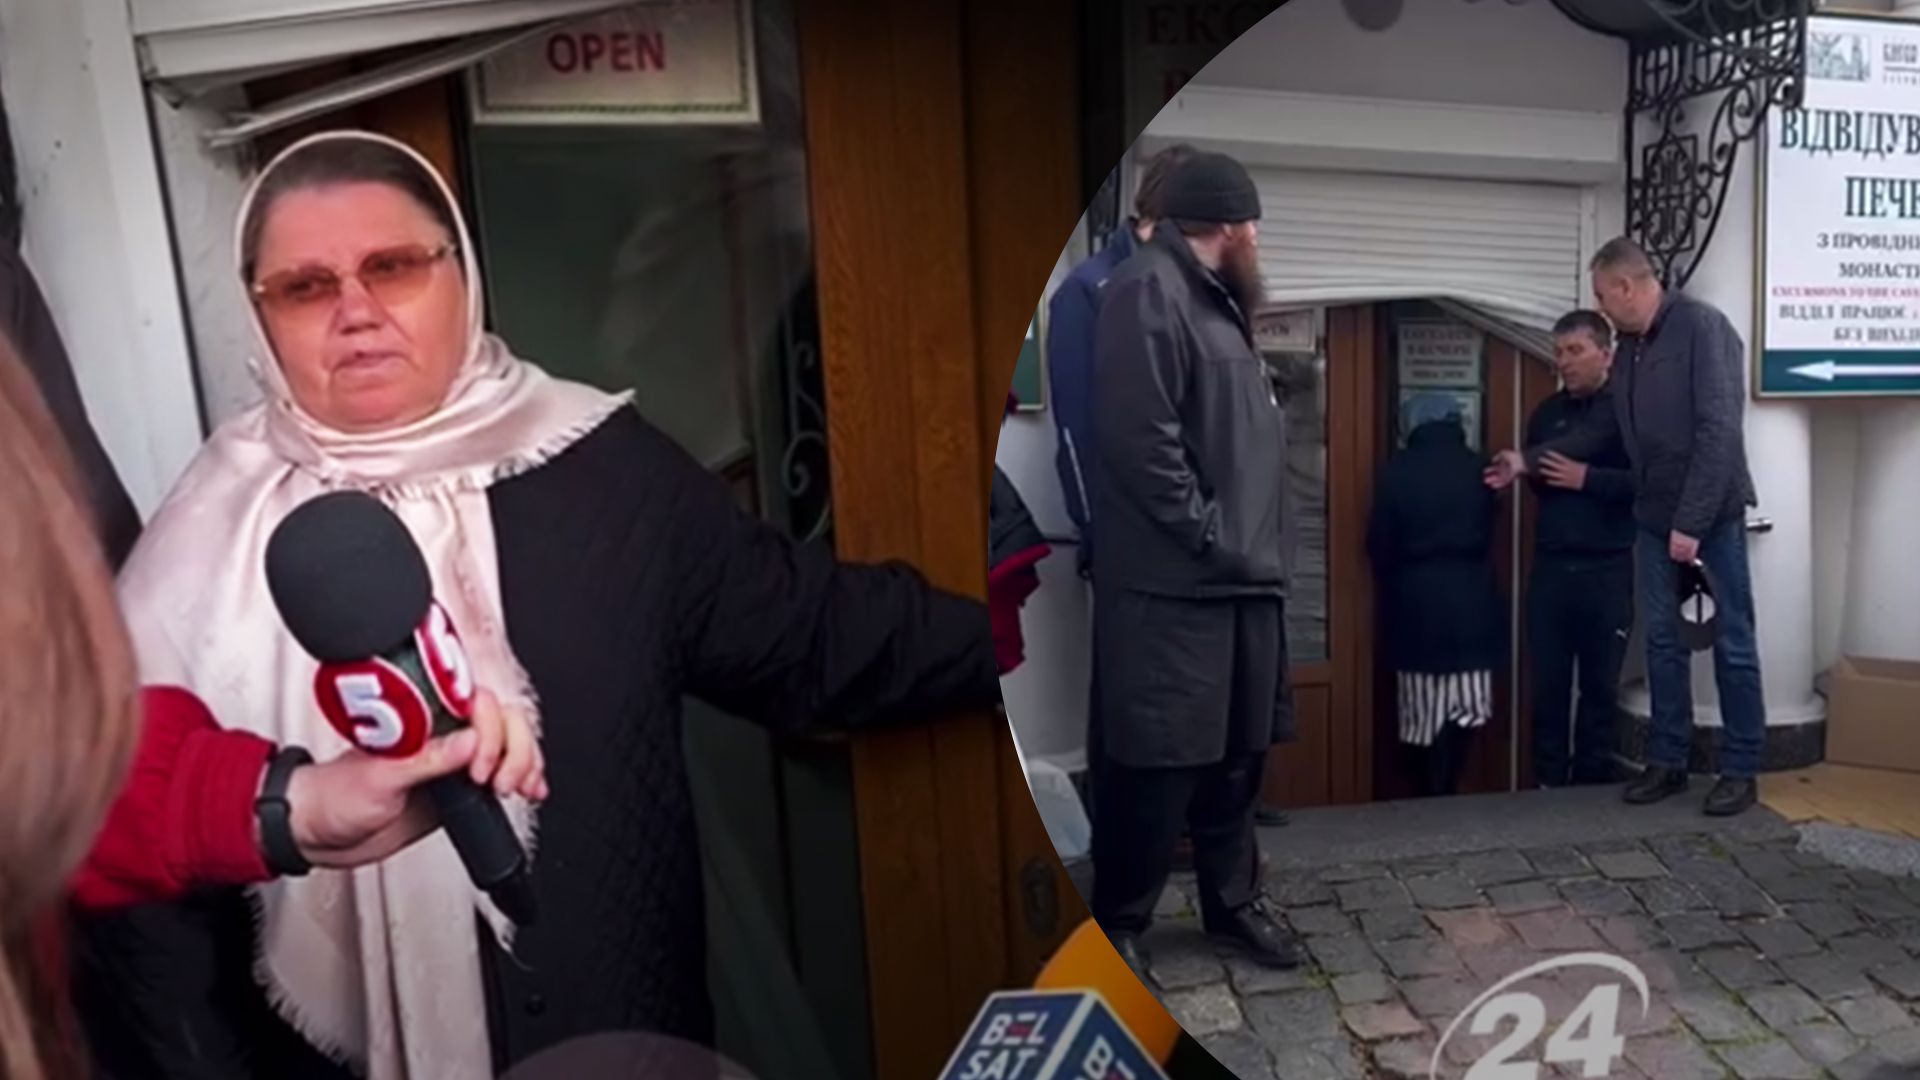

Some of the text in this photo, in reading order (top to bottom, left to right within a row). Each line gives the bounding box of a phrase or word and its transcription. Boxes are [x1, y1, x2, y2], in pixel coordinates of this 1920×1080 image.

[545, 31, 668, 74] OPEN
[334, 672, 404, 748] 5
[958, 1048, 1037, 1080] SAT
